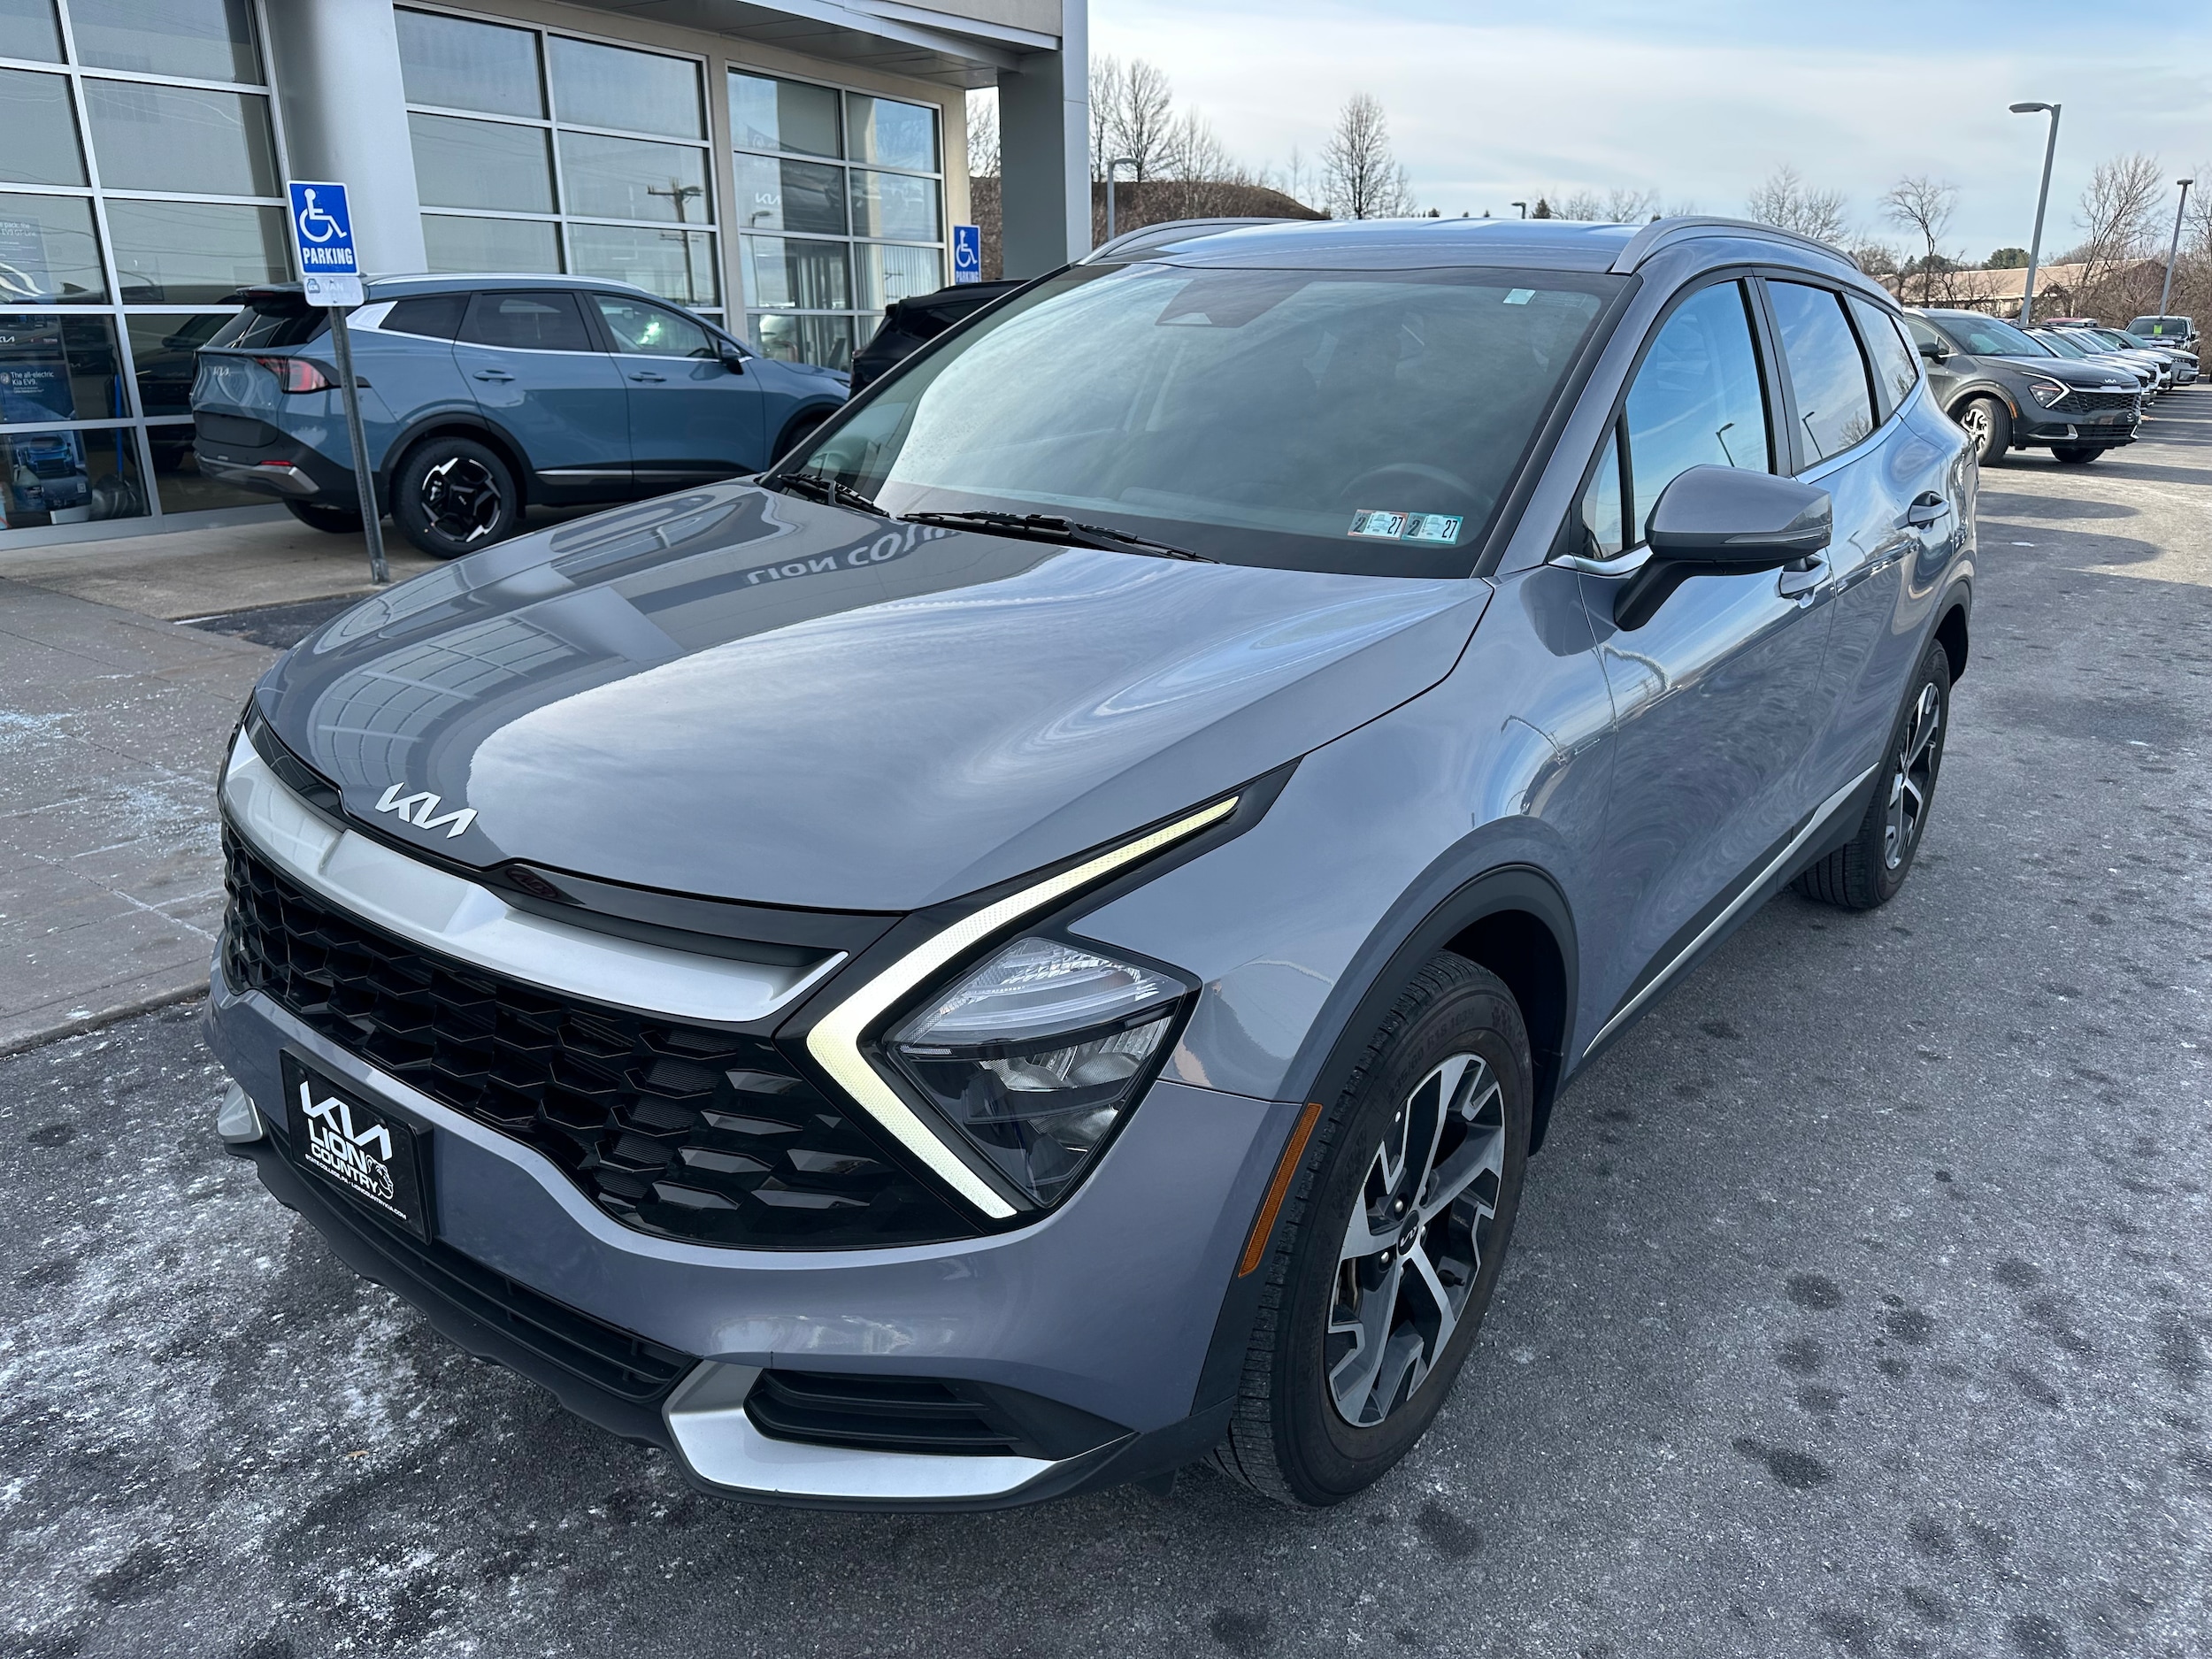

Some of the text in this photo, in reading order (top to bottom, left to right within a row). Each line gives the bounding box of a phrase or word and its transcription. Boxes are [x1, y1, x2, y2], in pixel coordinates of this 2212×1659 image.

[302, 247, 354, 265] PARKING
[956, 270, 979, 283] PARKING
[322, 282, 344, 292] VAN
[1387, 516, 1404, 536] 27
[1407, 519, 1421, 536] 2
[1441, 519, 1458, 539] 27
[374, 781, 479, 839] KIA
[299, 1080, 393, 1161] KIA
[307, 1118, 368, 1175] LION
[311, 1142, 379, 1194] COUNTRY
